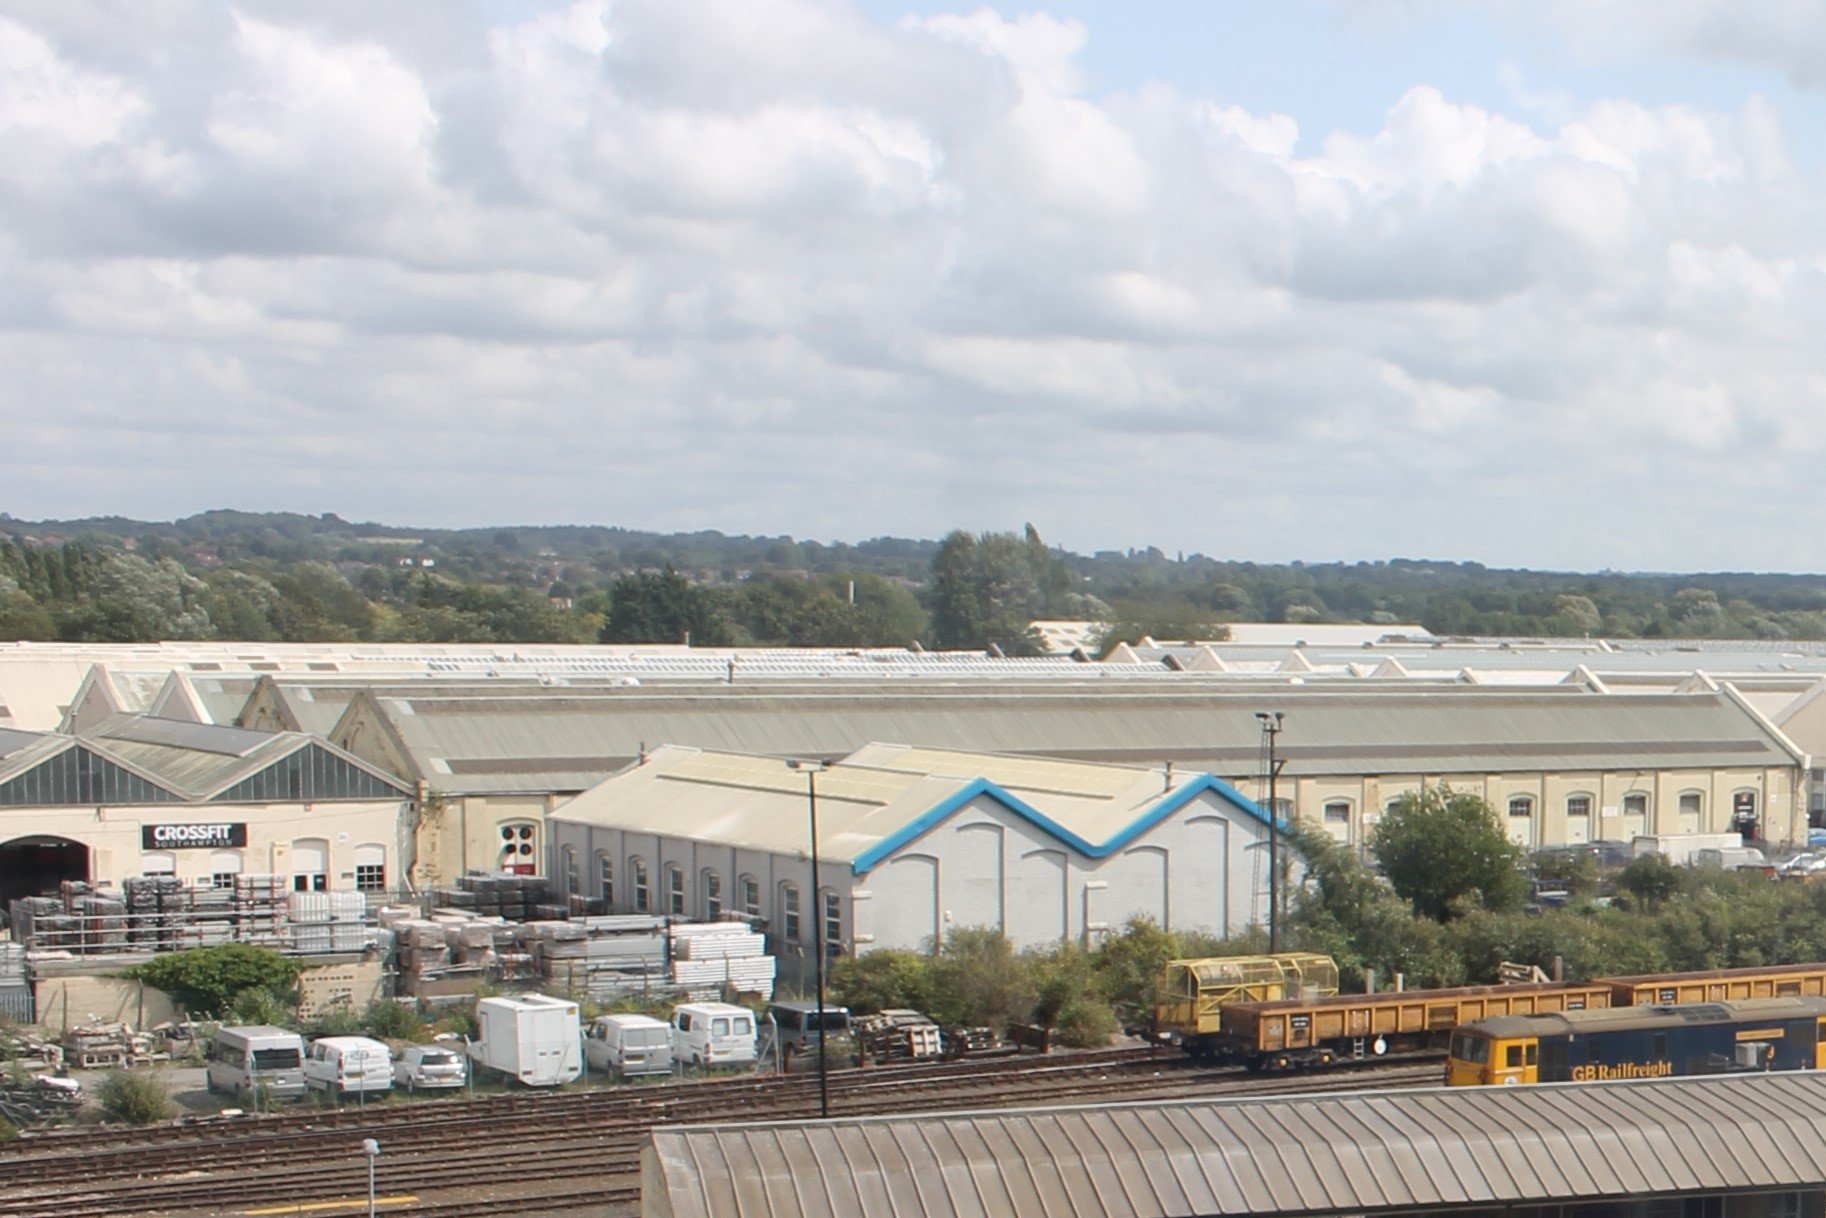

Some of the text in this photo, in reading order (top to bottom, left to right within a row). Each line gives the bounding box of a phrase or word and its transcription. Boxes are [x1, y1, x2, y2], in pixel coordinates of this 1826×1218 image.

[154, 824, 233, 841] CROSSFIT
[1572, 1060, 1674, 1082] GB Railfreight
